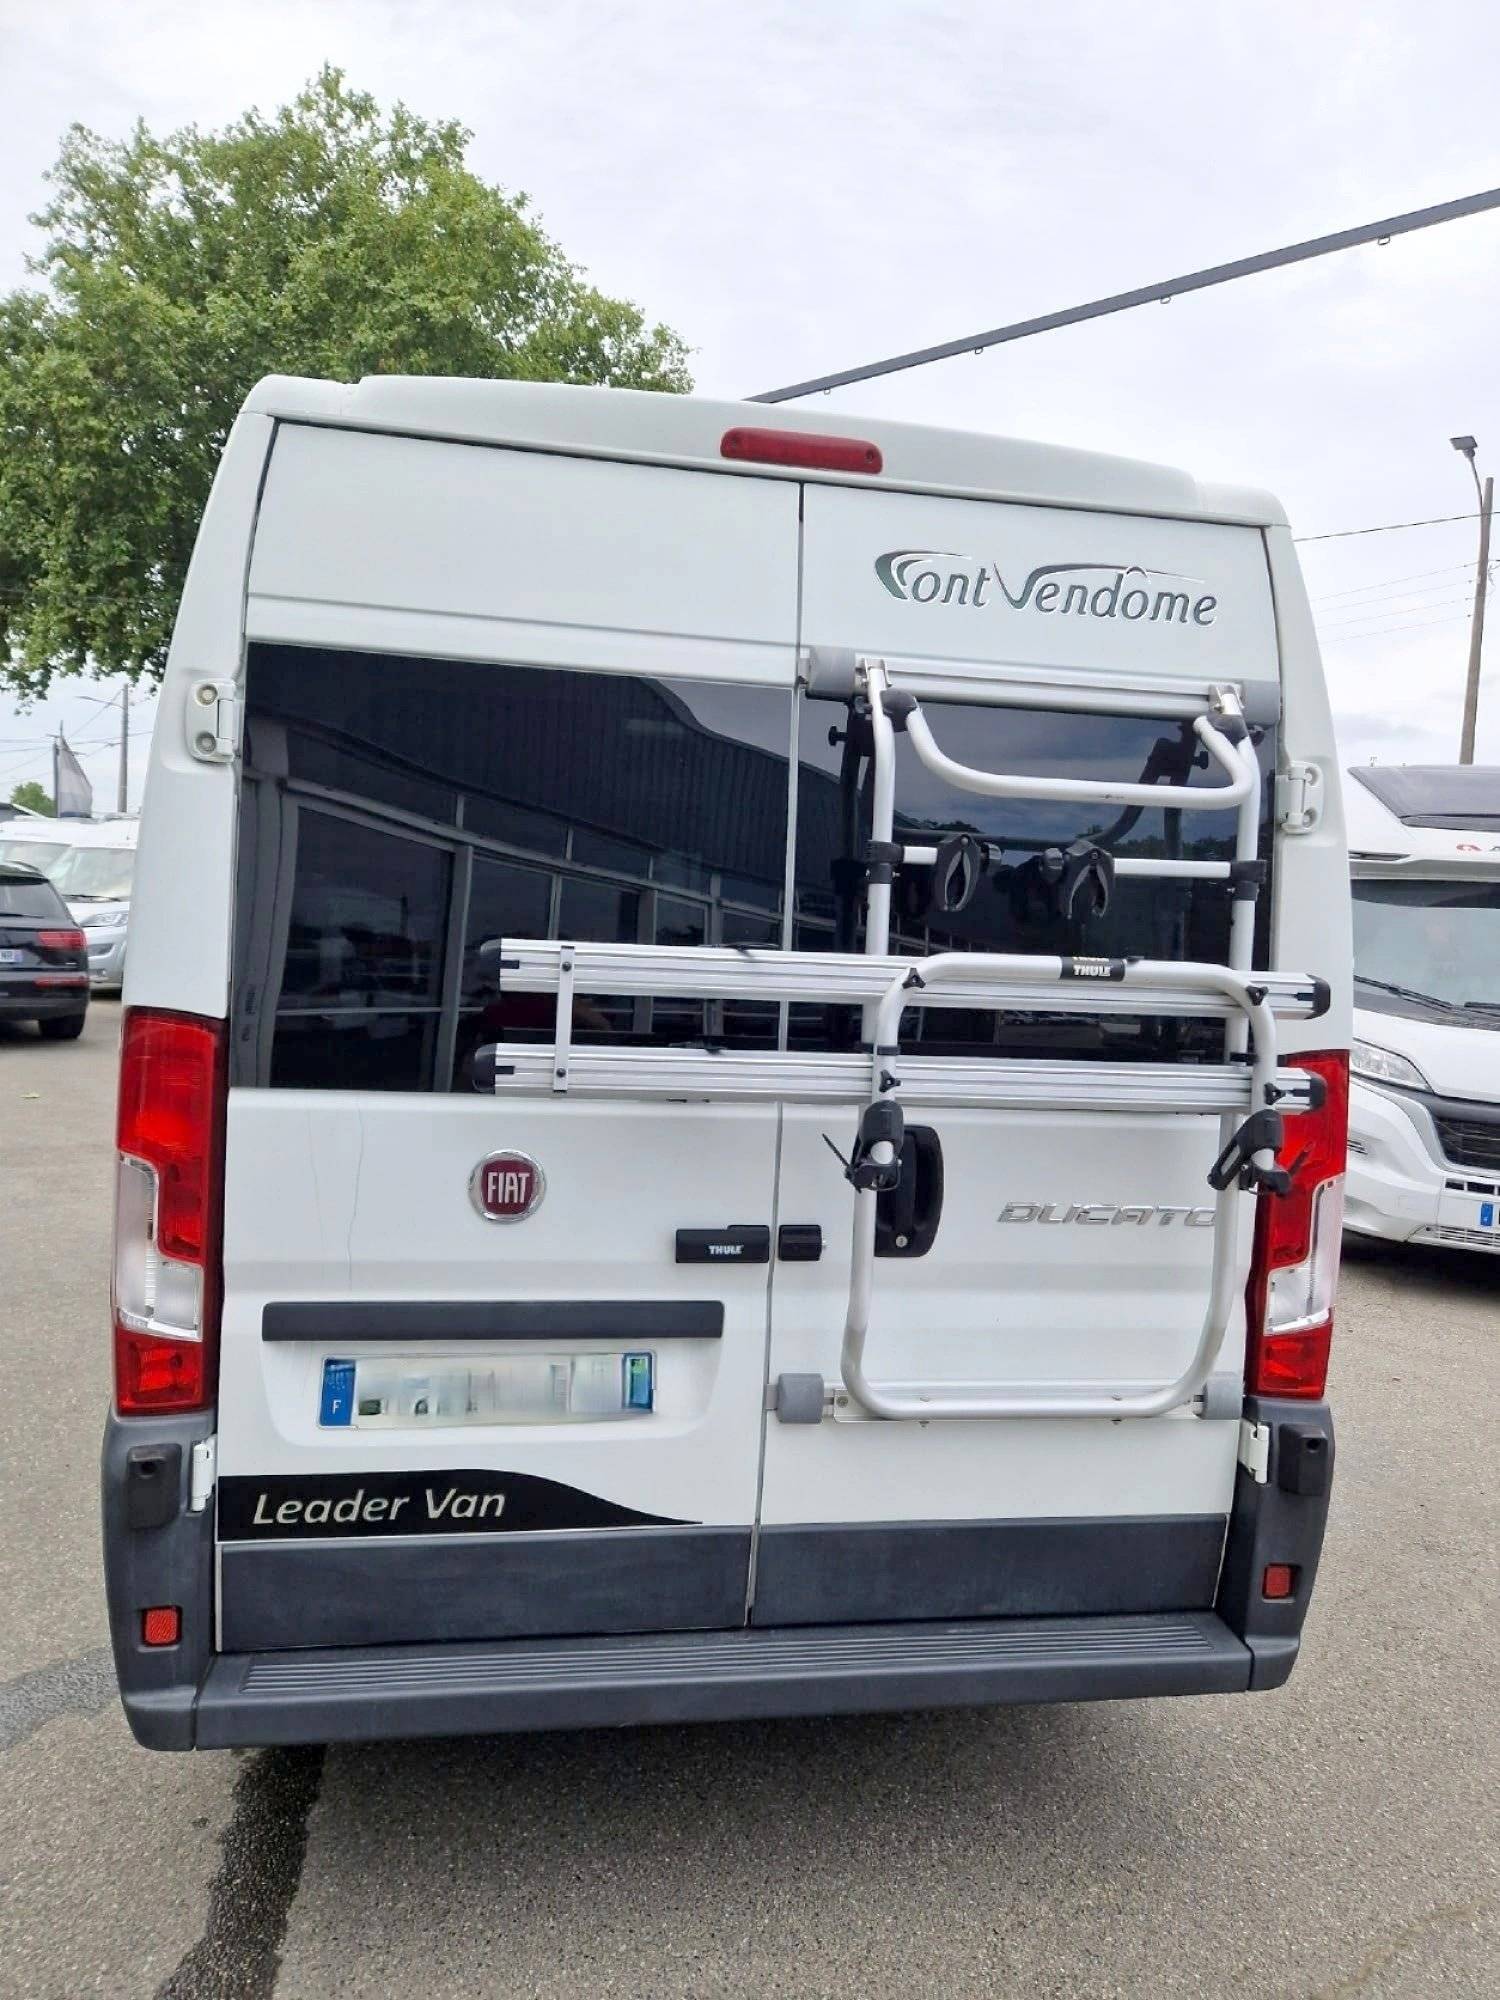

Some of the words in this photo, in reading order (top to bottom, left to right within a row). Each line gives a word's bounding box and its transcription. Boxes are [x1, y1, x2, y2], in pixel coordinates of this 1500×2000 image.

[1073, 965, 1111, 977] THULE
[487, 1171, 530, 1204] FIAT
[998, 1200, 1216, 1227] DUCATO
[708, 1244, 744, 1255] THULE
[332, 1399, 342, 1415] F
[253, 1488, 410, 1525] Leader
[425, 1488, 505, 1519] Van
